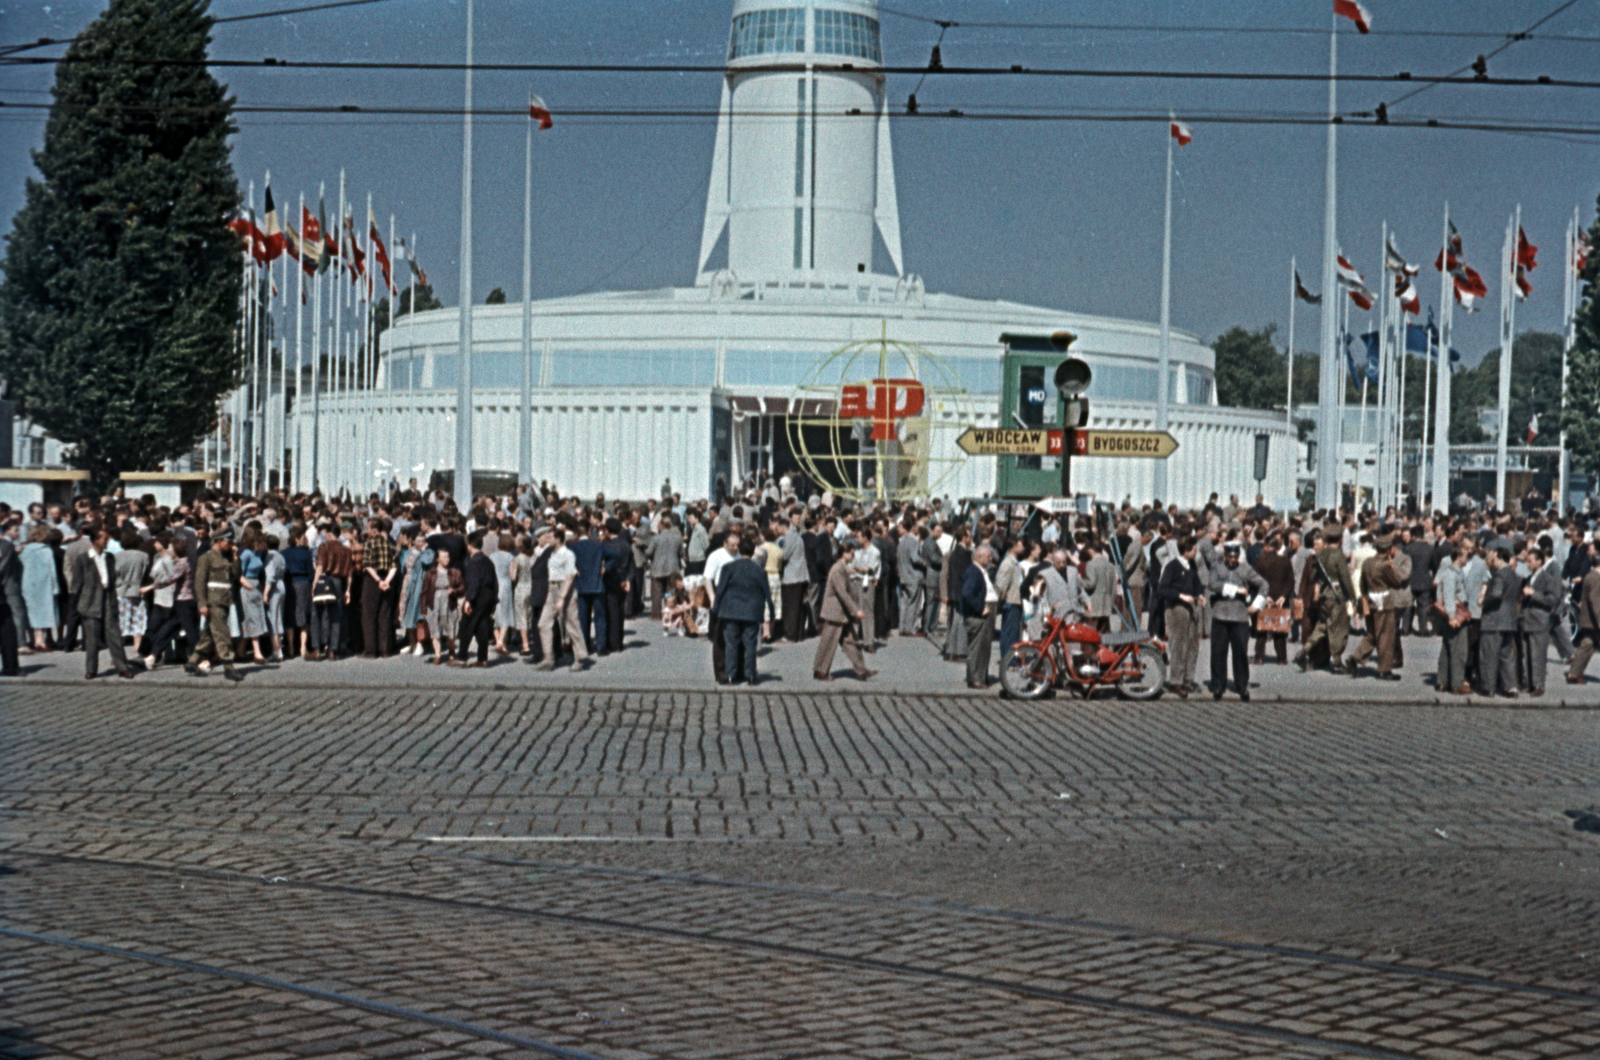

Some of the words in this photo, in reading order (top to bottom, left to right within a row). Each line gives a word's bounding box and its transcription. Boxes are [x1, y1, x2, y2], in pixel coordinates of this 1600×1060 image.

[1029, 389, 1045, 402] MO
[974, 430, 1041, 444] WROCŁAW
[1094, 436, 1160, 451] BYDGOSZCZ
